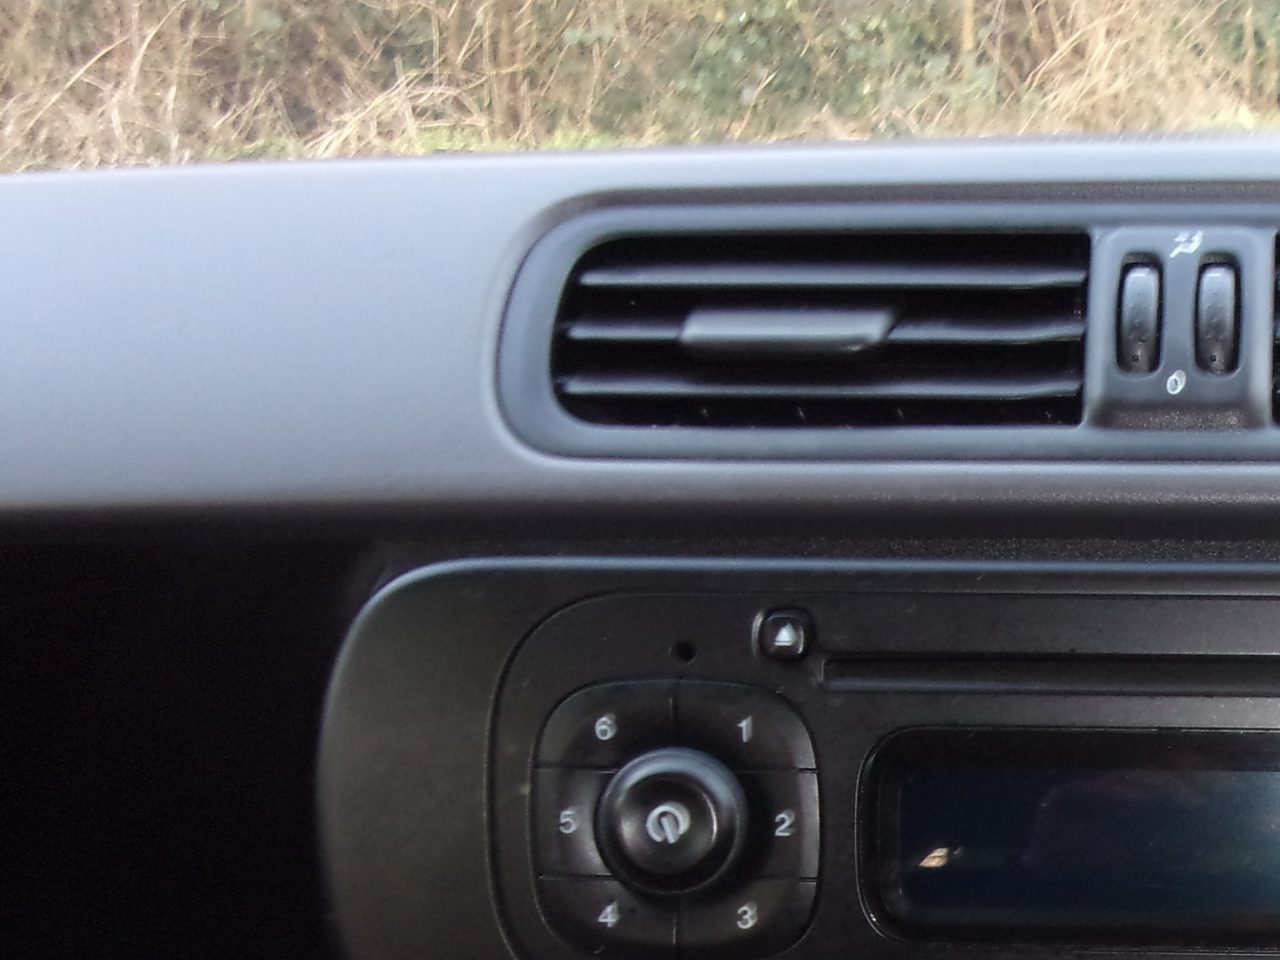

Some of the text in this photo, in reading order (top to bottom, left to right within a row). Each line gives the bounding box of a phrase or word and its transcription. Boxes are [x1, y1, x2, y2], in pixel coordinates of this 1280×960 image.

[594, 715, 616, 741] 6
[737, 717, 752, 743] 1
[559, 811, 578, 834] 5
[774, 812, 794, 837] 2
[598, 902, 618, 928] 4
[736, 904, 757, 929] 3
